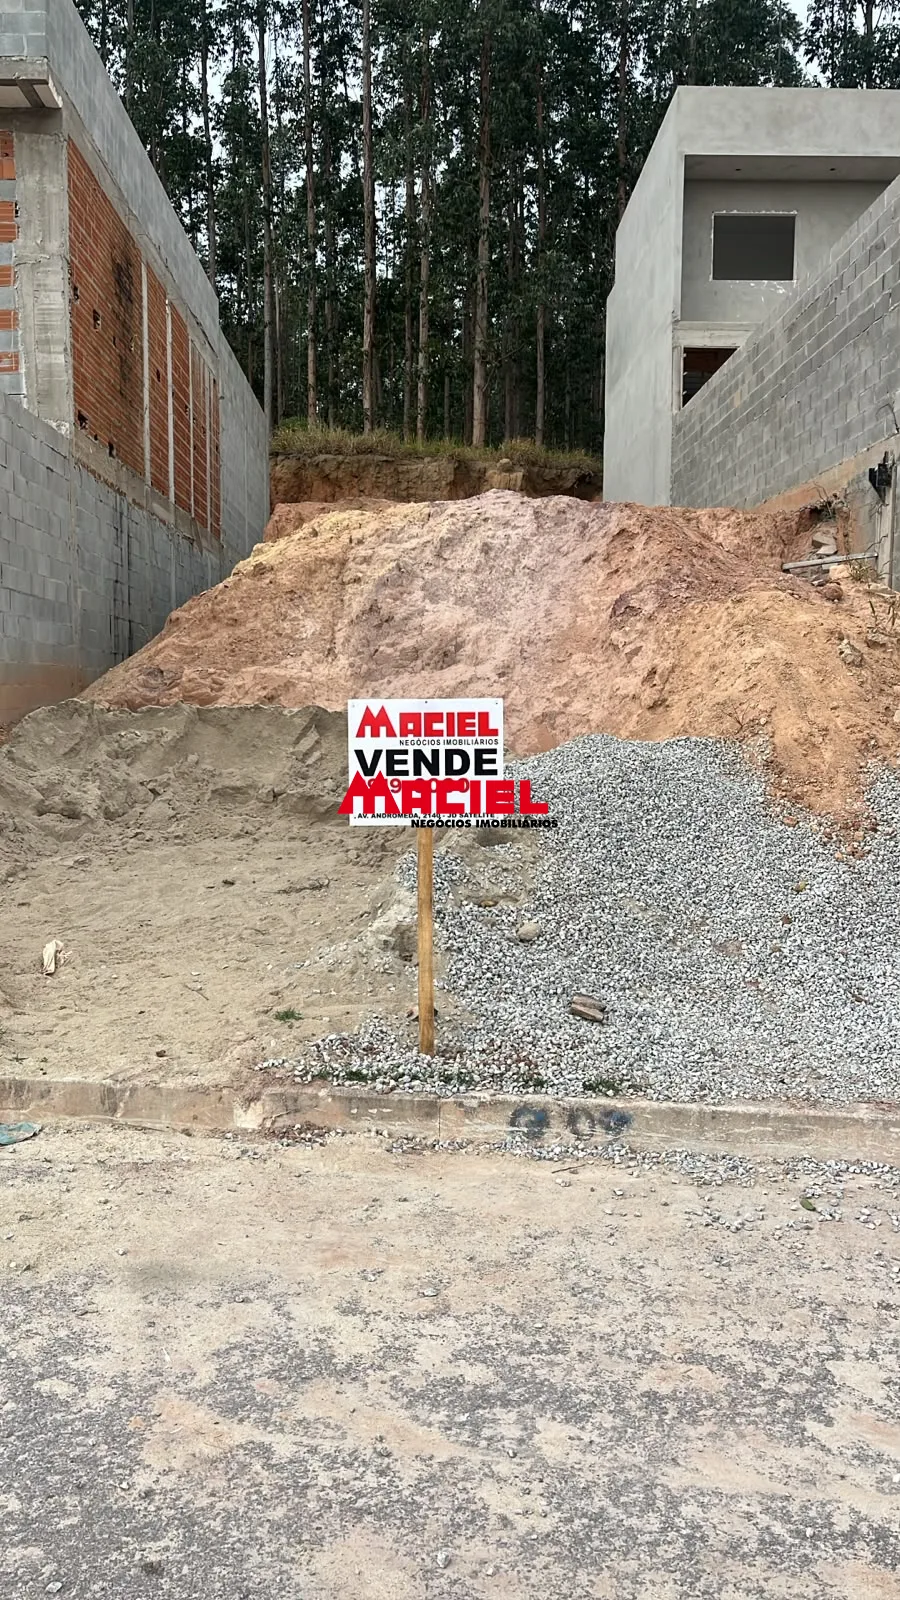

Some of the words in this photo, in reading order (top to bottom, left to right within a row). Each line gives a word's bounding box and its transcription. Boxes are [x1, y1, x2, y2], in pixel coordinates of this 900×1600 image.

[355, 705, 499, 738] MACIEL
[399, 738, 441, 746] NEGÓCIOS
[443, 738, 499, 746] IMOBILIÁRIOS
[354, 748, 498, 777] VENDE
